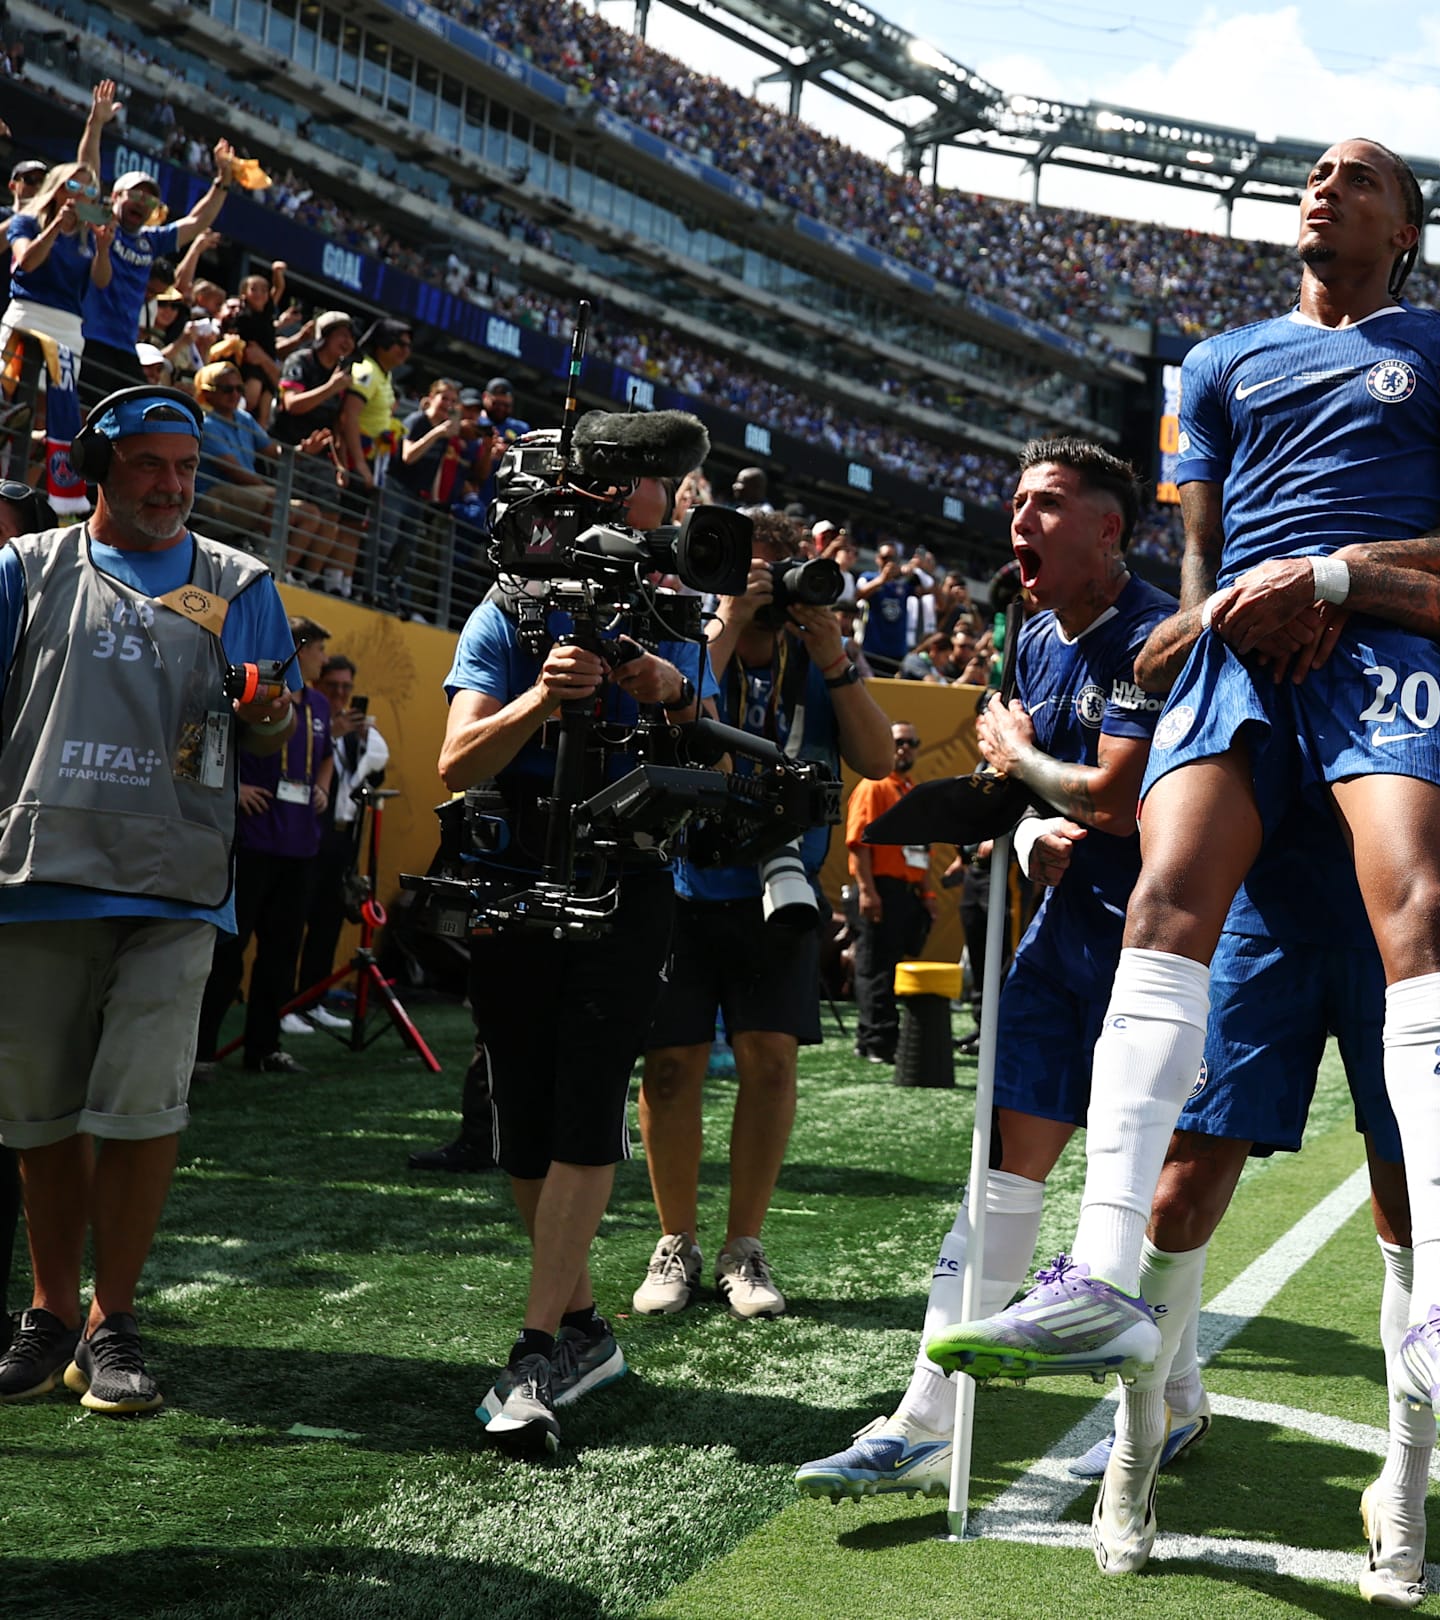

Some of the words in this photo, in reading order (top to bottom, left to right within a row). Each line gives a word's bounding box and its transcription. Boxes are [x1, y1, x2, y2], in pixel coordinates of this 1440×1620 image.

[322, 242, 362, 291] GOAL
[554, 509, 575, 518] SONY
[1111, 678, 1146, 700] LIVE
[1359, 665, 1440, 729] 20
[58, 767, 151, 787] FIFAPLUS.COM
